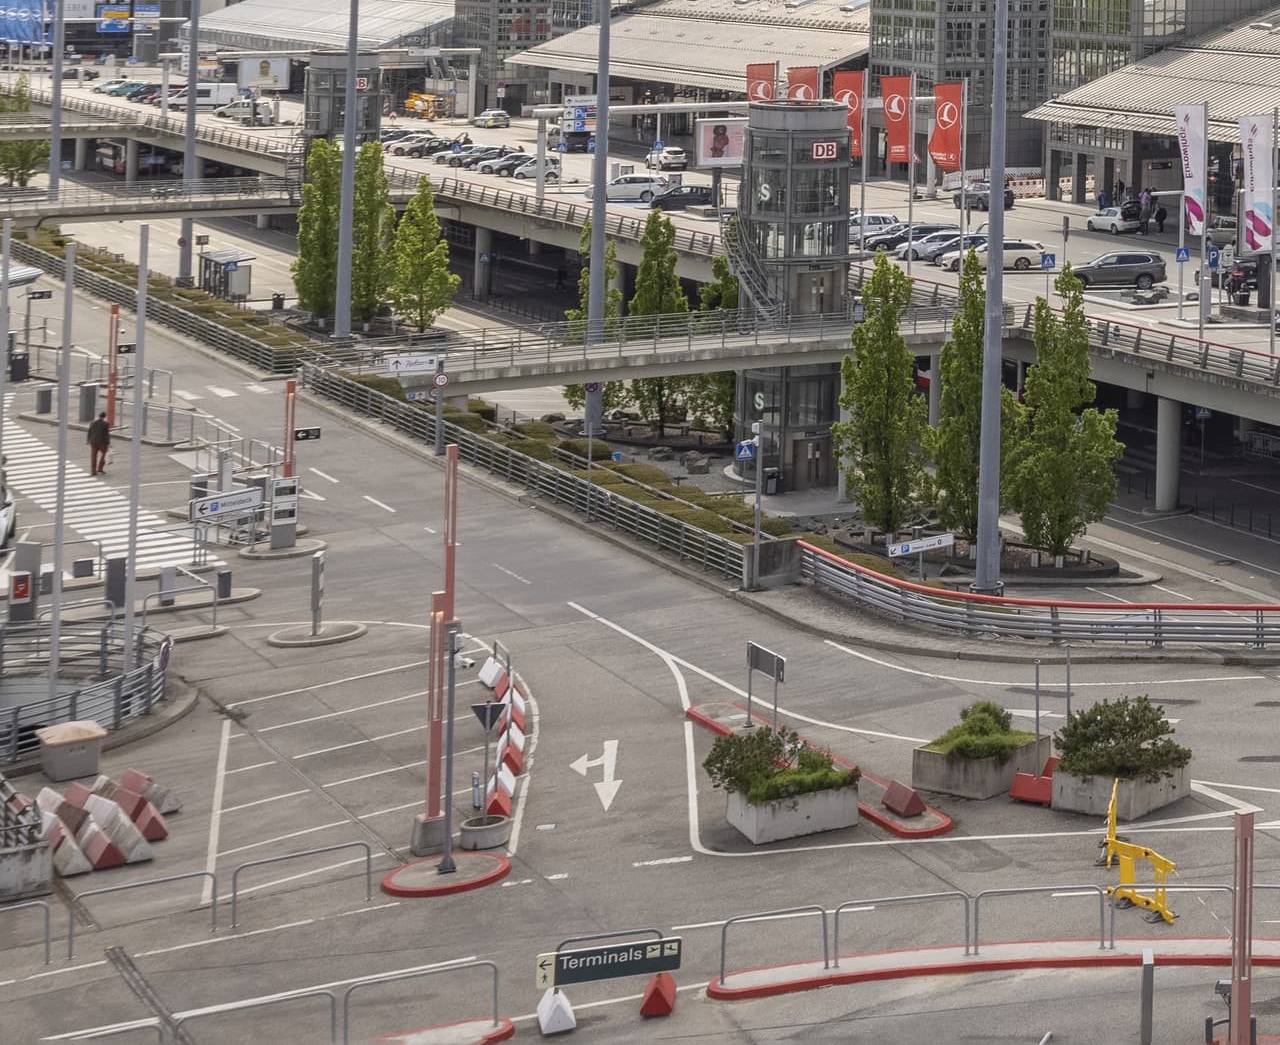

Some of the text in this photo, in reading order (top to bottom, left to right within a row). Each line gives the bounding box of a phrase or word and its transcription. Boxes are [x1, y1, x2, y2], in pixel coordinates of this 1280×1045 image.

[814, 143, 836, 158] DB
[760, 183, 771, 201] S
[437, 376, 446, 384] 10
[754, 392, 764, 410] S
[560, 948, 643, 970] Terminals
